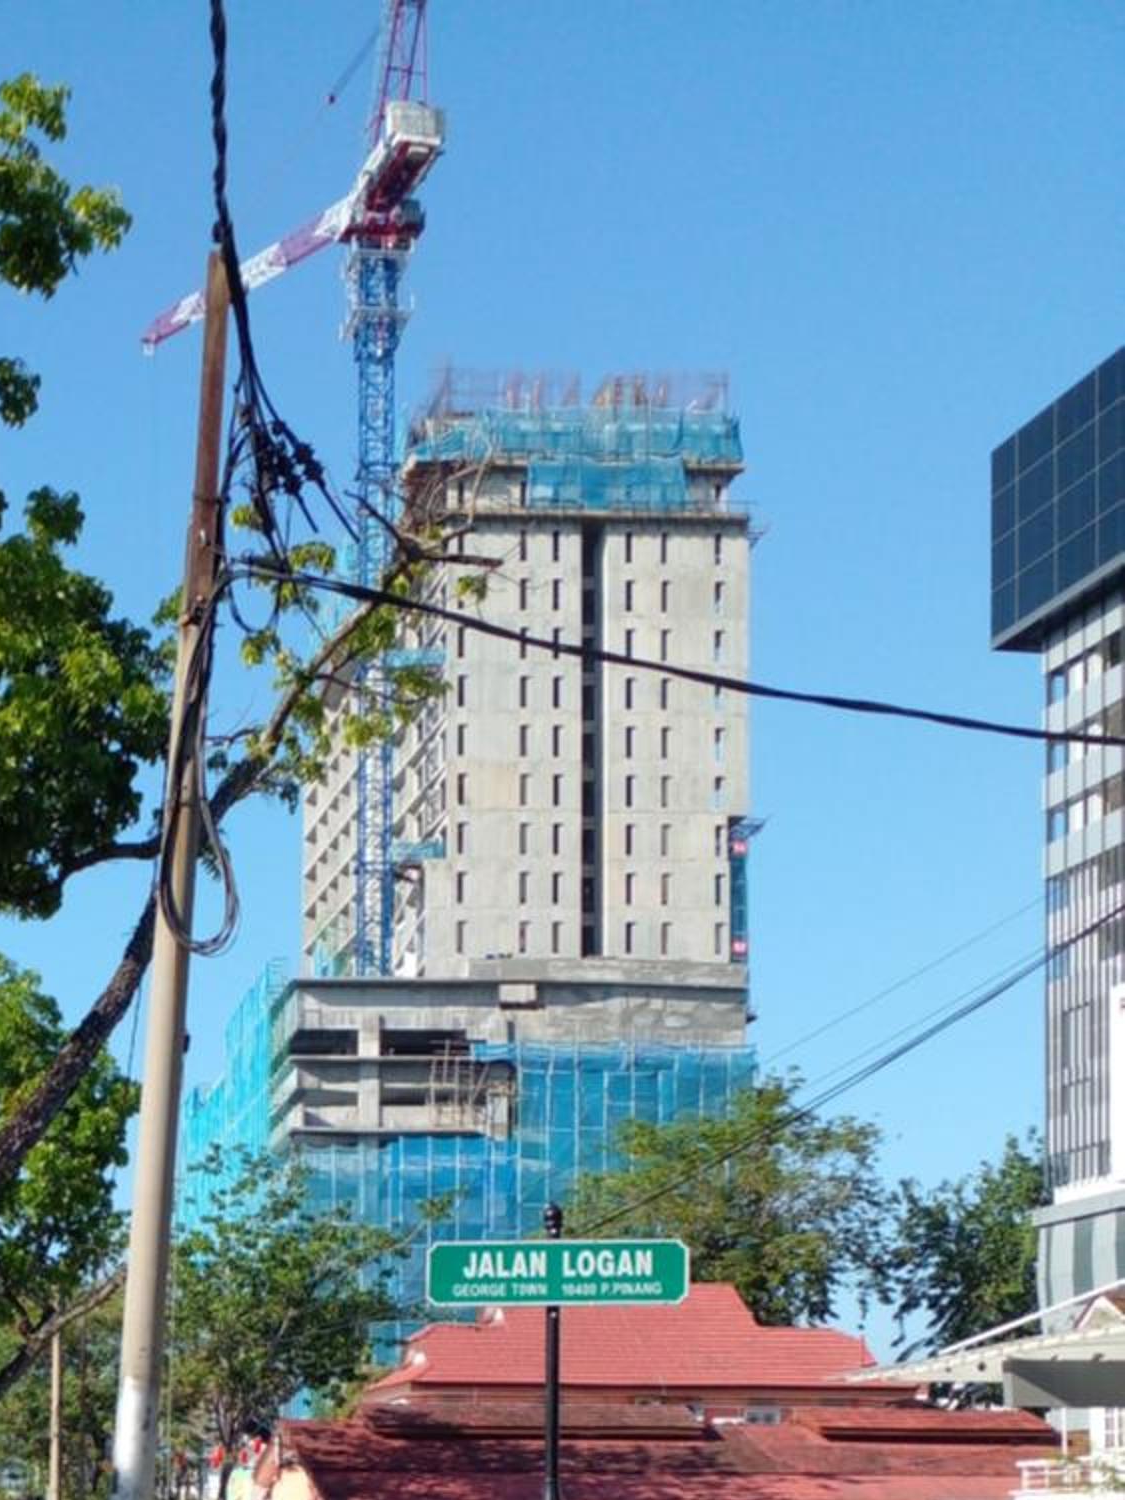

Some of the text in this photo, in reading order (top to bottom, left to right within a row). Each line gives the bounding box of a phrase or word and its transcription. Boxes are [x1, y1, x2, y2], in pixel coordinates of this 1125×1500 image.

[463, 1249, 653, 1278] JALAN LOGAN
[453, 1283, 506, 1297] GEORGE
[512, 1283, 547, 1296] TOWN
[601, 1281, 662, 1296] P.PINANG
